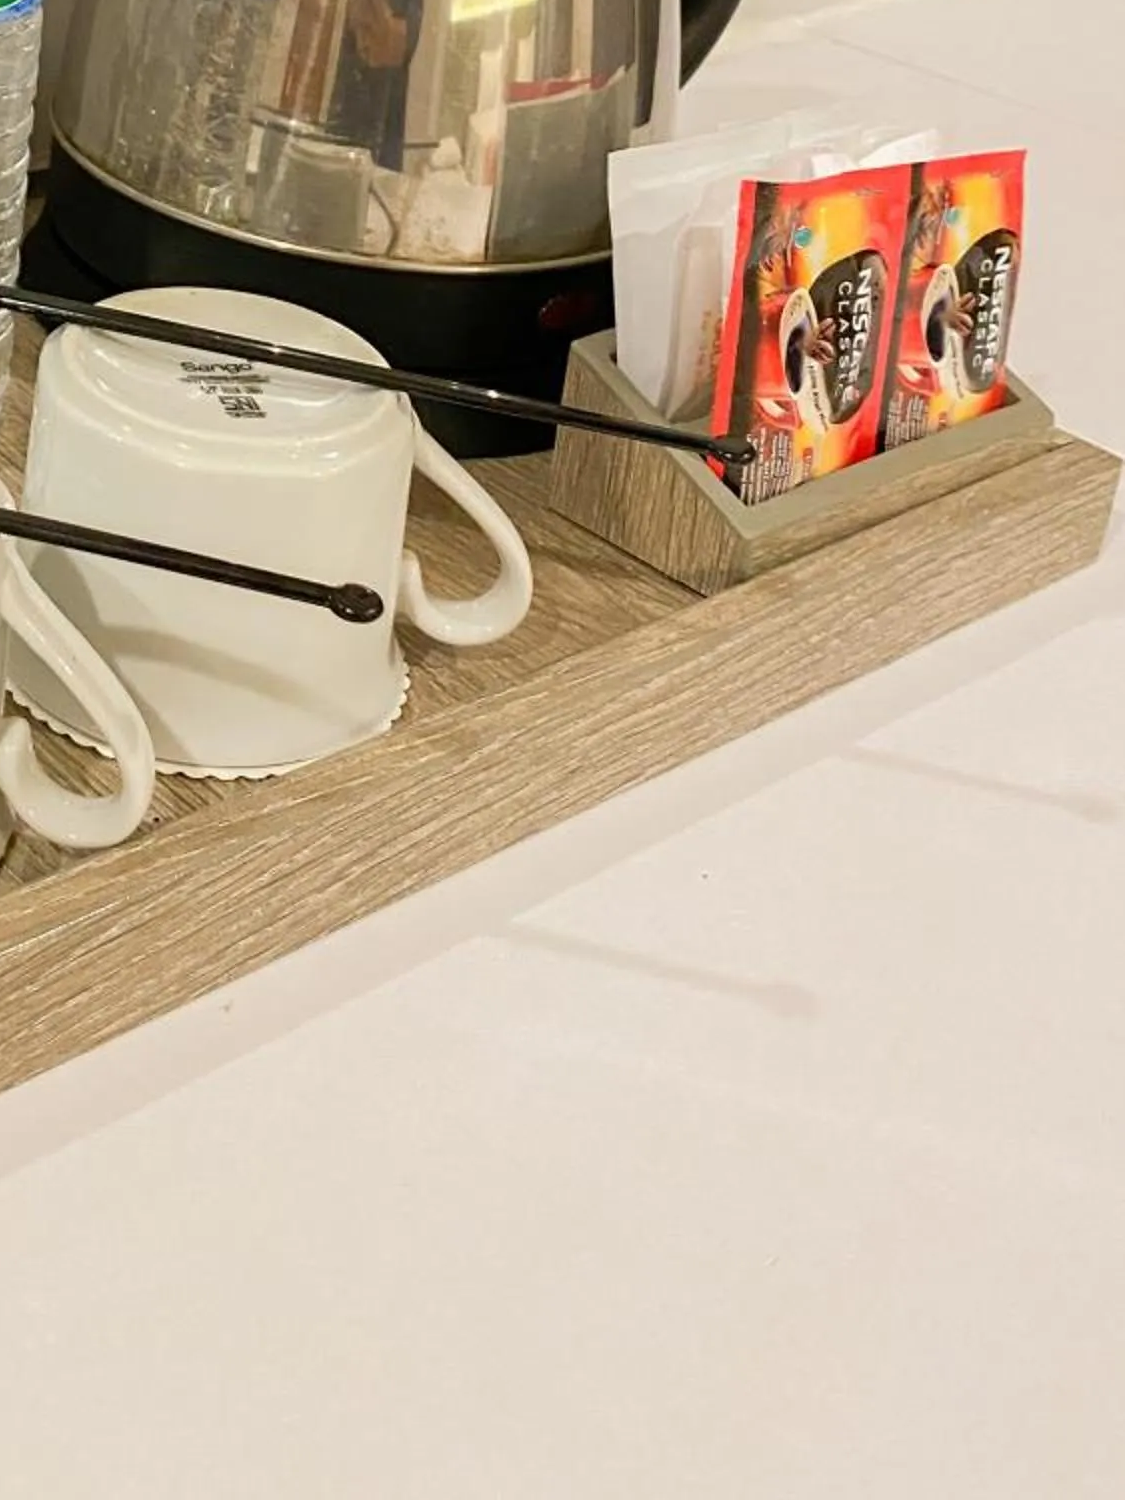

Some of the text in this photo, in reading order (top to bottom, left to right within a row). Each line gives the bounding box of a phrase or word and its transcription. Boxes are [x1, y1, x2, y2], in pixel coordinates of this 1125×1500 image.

[834, 281, 854, 398] CLASSIC
[972, 258, 994, 369] CLASSIC
[180, 361, 252, 374] Sango
[218, 395, 261, 411] SNI
